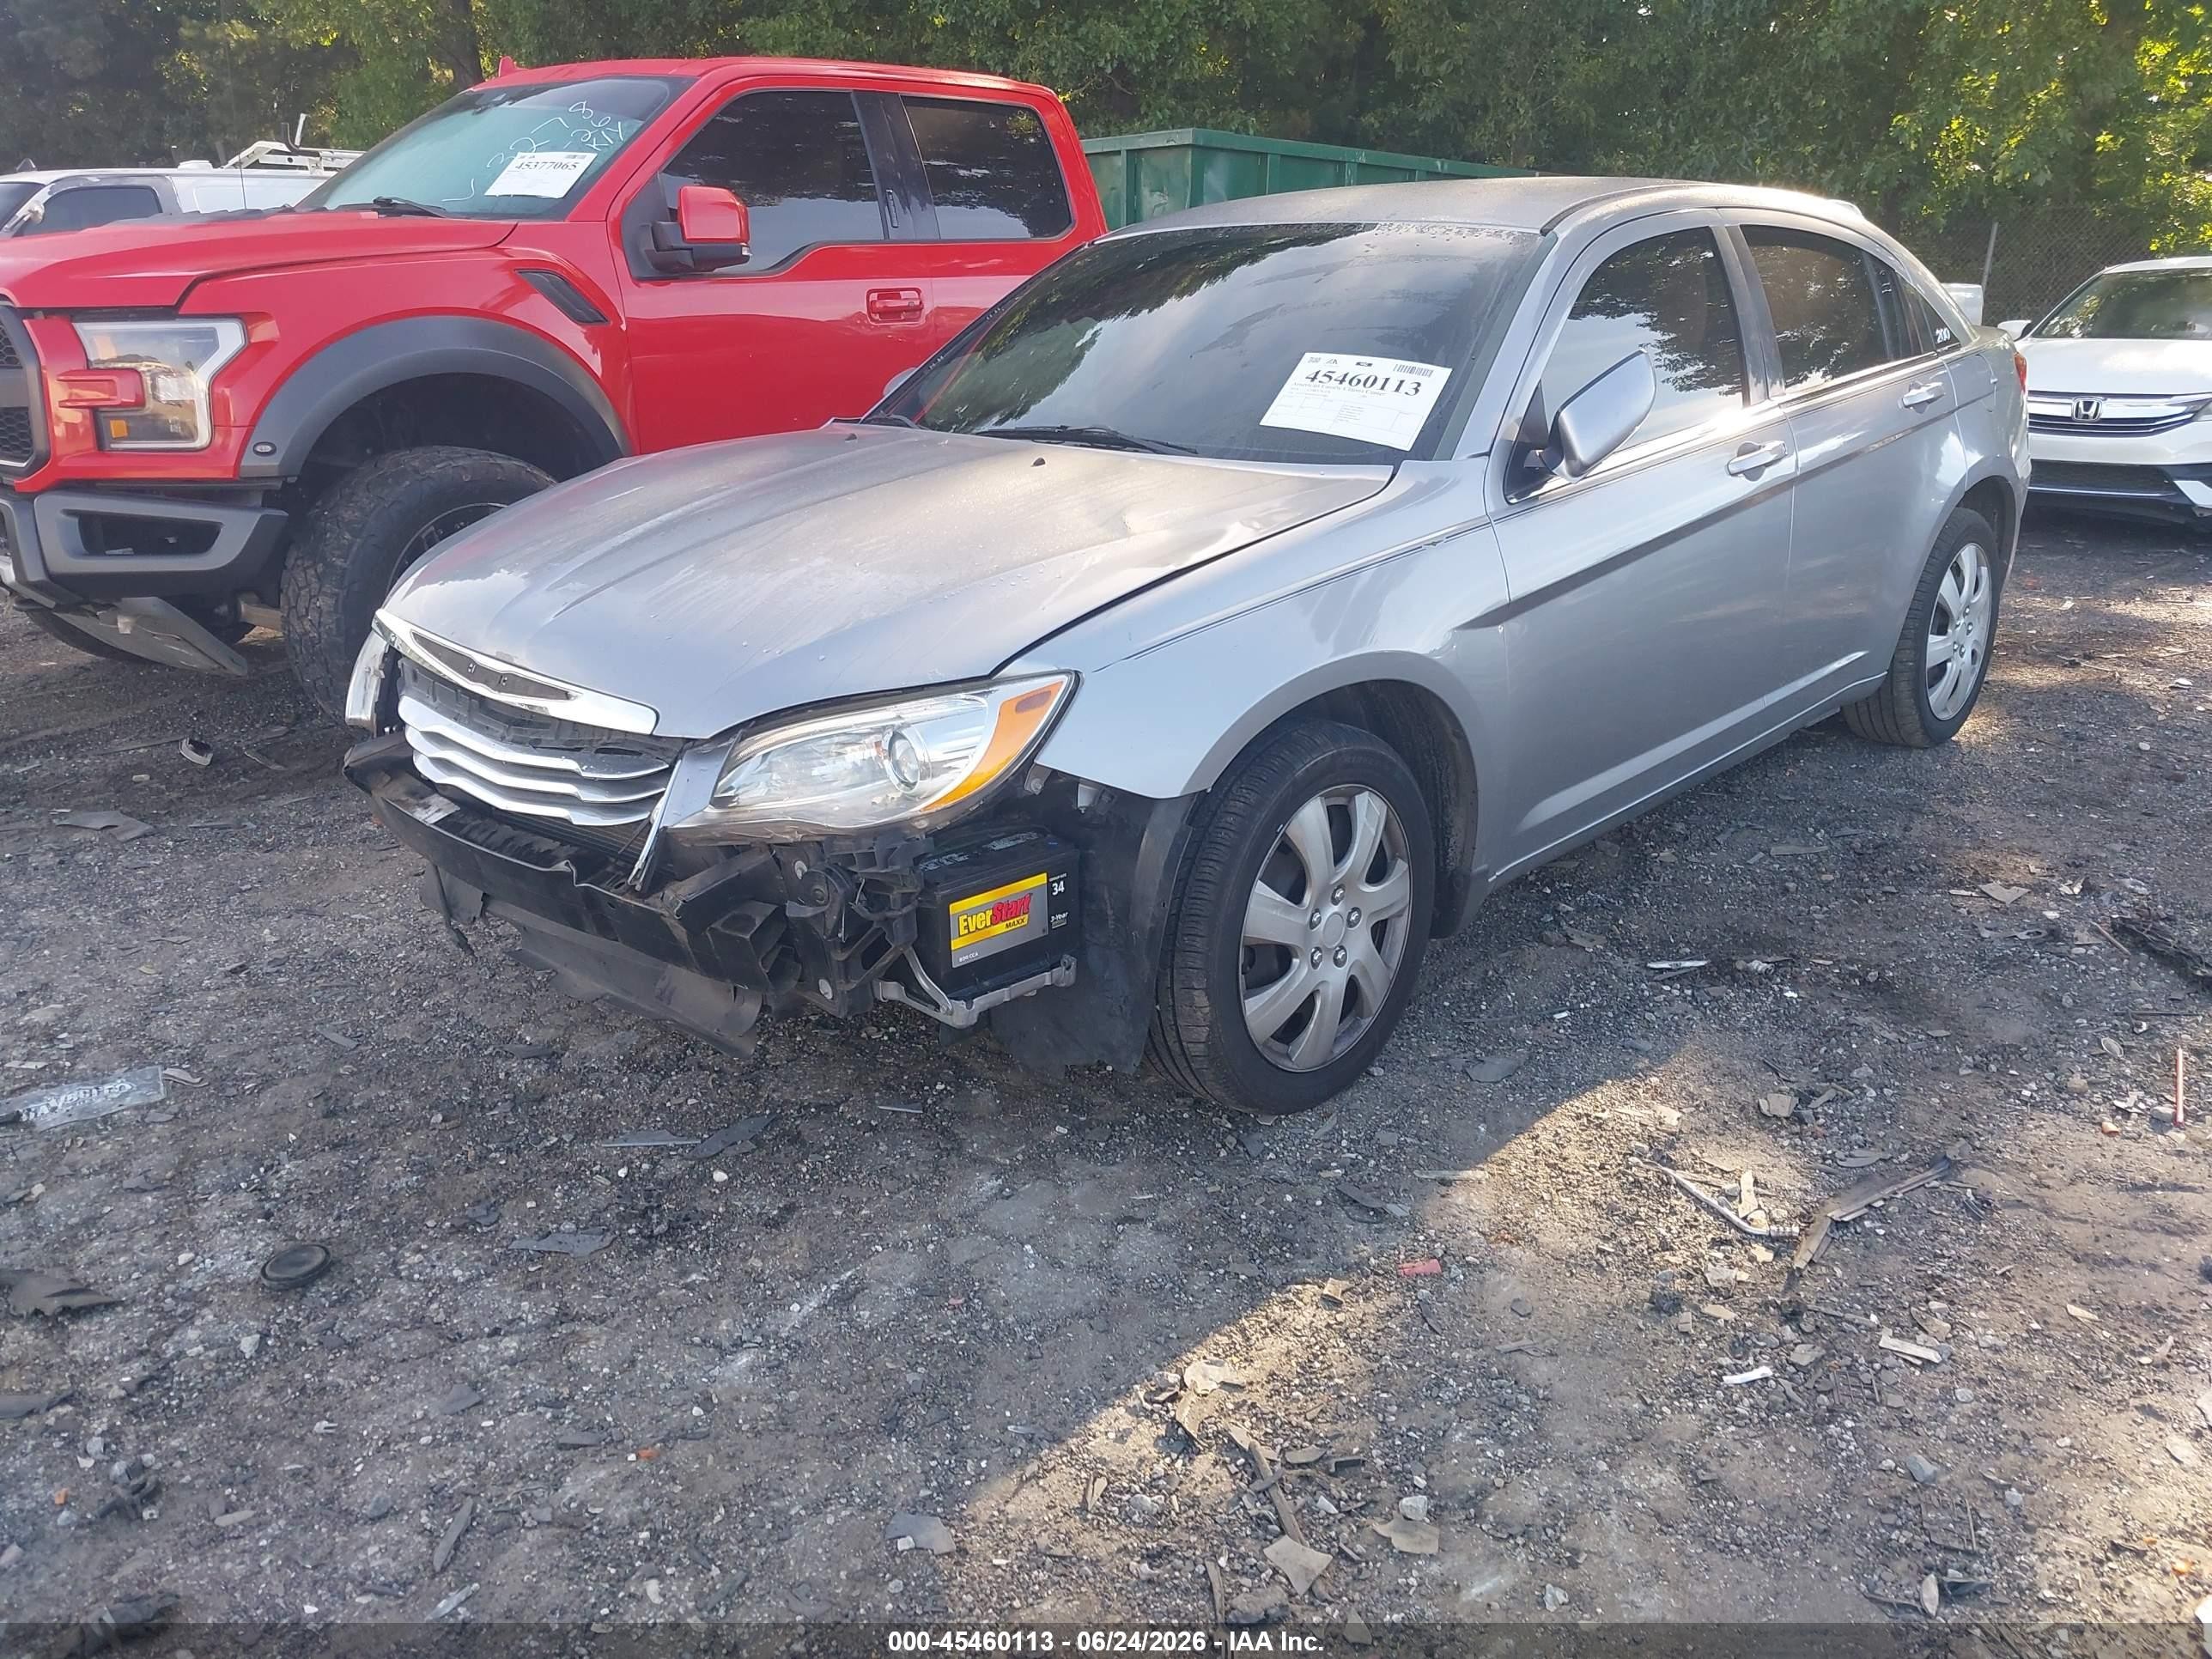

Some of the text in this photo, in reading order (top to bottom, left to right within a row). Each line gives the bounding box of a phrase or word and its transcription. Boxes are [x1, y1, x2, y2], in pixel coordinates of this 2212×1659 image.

[515, 161, 580, 171] 45377065
[1936, 327, 1951, 343] 200
[1305, 369, 1422, 397] 45460113
[1052, 880, 1065, 896] 34
[957, 893, 1032, 937] EverStart
[1005, 916, 1026, 930] MAXX
